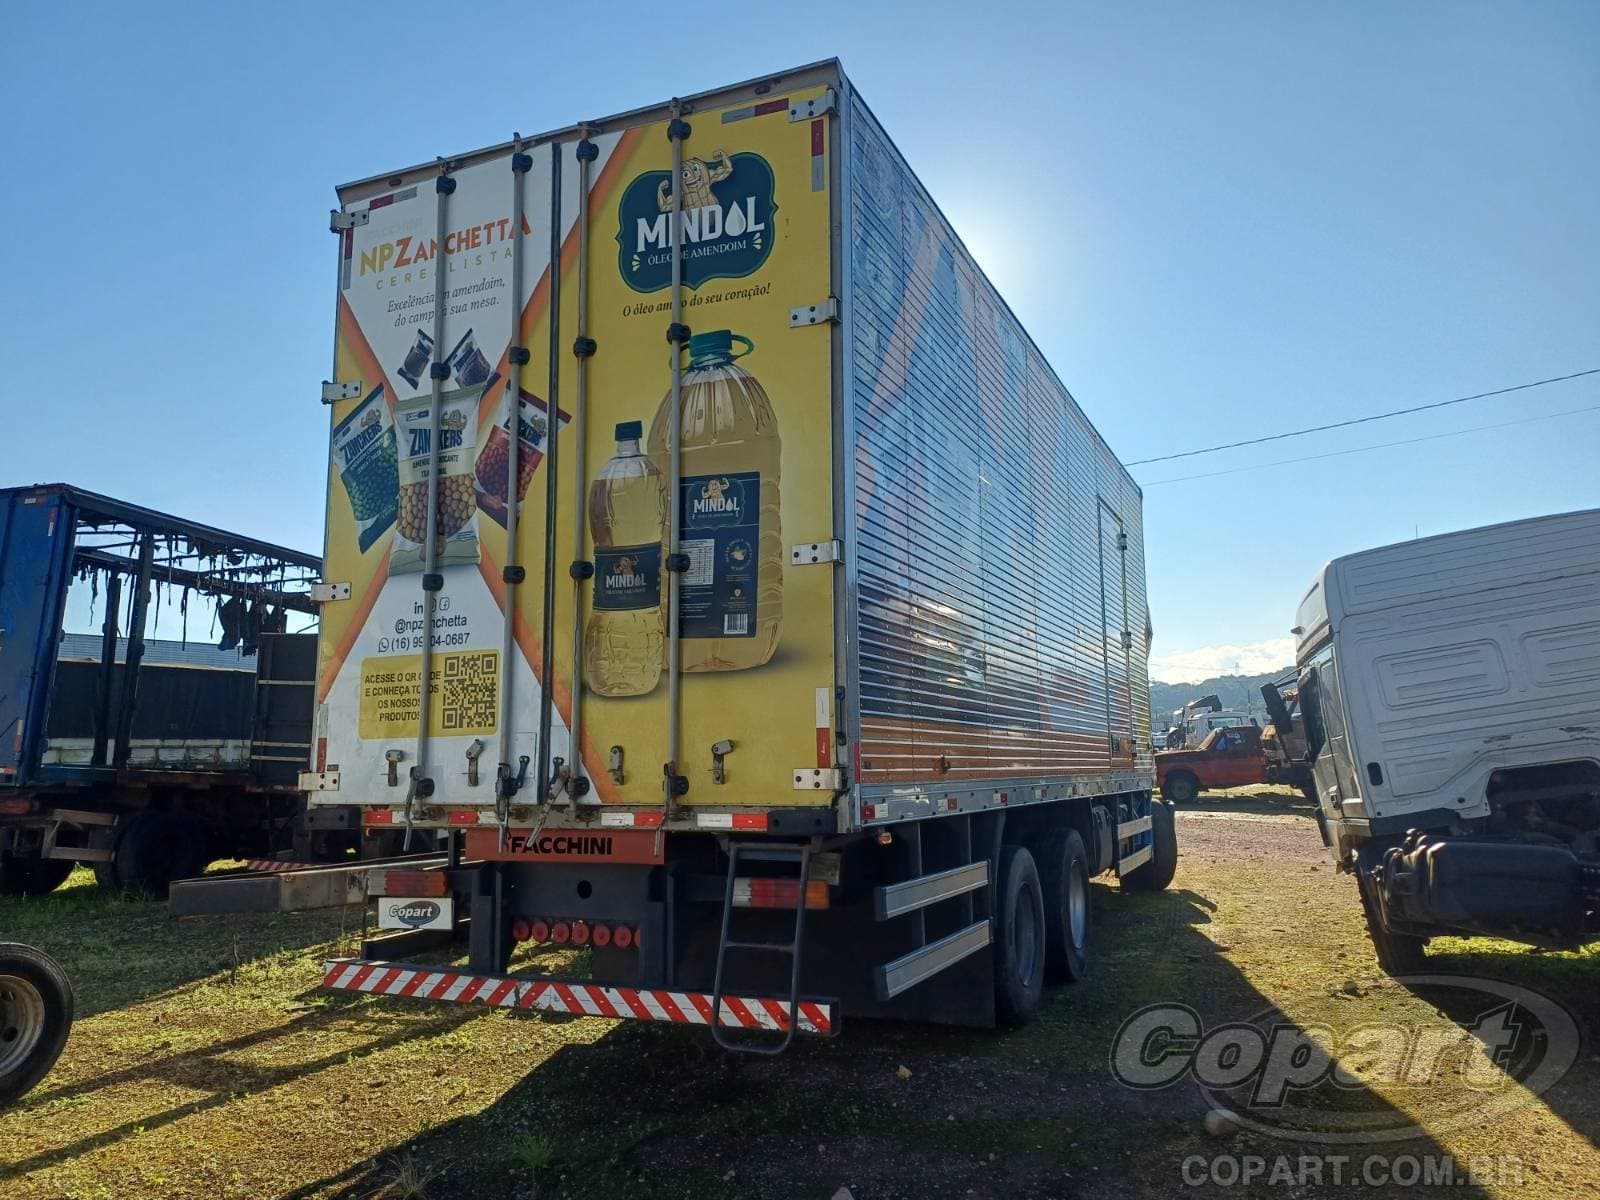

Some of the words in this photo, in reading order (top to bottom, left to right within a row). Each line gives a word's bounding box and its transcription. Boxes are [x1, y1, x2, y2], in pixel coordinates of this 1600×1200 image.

[690, 239, 747, 259] AMENDOIM
[376, 247, 512, 290] CERELISTA
[387, 291, 435, 313] Excelência
[452, 276, 505, 298] amendoim,
[622, 305, 631, 317] O
[633, 302, 654, 316] óleo
[656, 300, 687, 313] amo
[689, 294, 703, 307] do
[705, 293, 723, 305] seu
[725, 282, 772, 300] coração!
[395, 313, 406, 328] do
[408, 309, 436, 325] camp
[450, 303, 467, 316] sua
[470, 295, 500, 311] mesa.
[408, 428, 463, 457] ZANKERS
[395, 614, 467, 633] @npznchetta
[391, 637, 410, 651] (16)
[412, 632, 470, 648] 9904-0687
[365, 673, 396, 684] ACESSE
[397, 672, 404, 683] O
[405, 671, 417, 682] QR
[418, 670, 442, 681] CDE
[365, 687, 371, 697] E
[372, 685, 410, 697] CONHEÇA
[411, 684, 440, 695] TOOS
[377, 699, 389, 709] OS
[511, 836, 613, 855] FACCHINI
[389, 905, 433, 919] Copart
